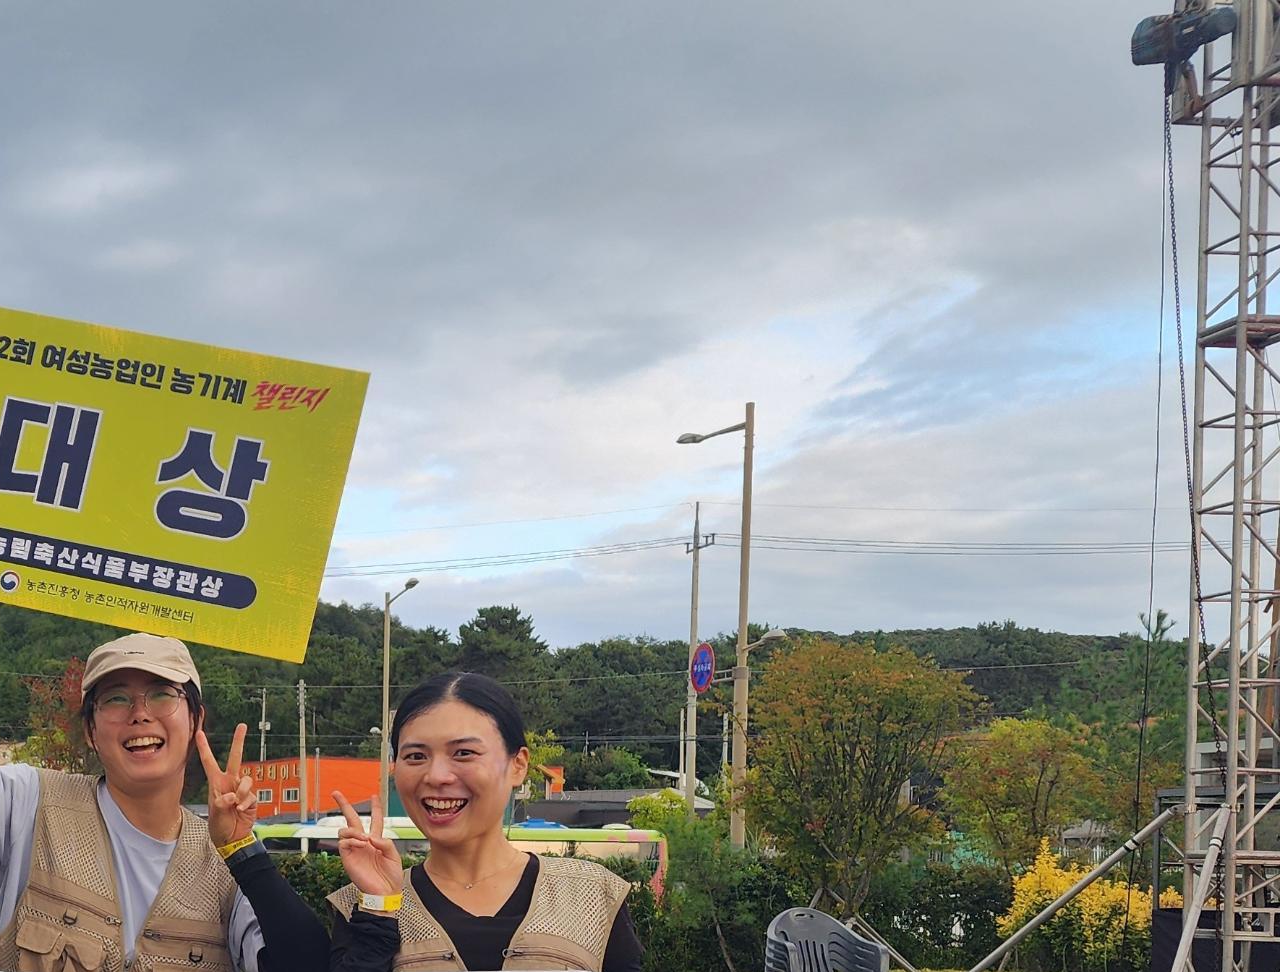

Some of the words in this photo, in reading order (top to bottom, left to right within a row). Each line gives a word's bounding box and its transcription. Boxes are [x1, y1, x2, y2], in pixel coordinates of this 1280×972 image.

[40, 344, 166, 391] 여성농업인
[169, 367, 249, 405] 농기계
[252, 380, 332, 414] 챌린지
[26, 578, 81, 600] 농촌진흥청
[84, 591, 195, 624] 농촌인적자원개발센터
